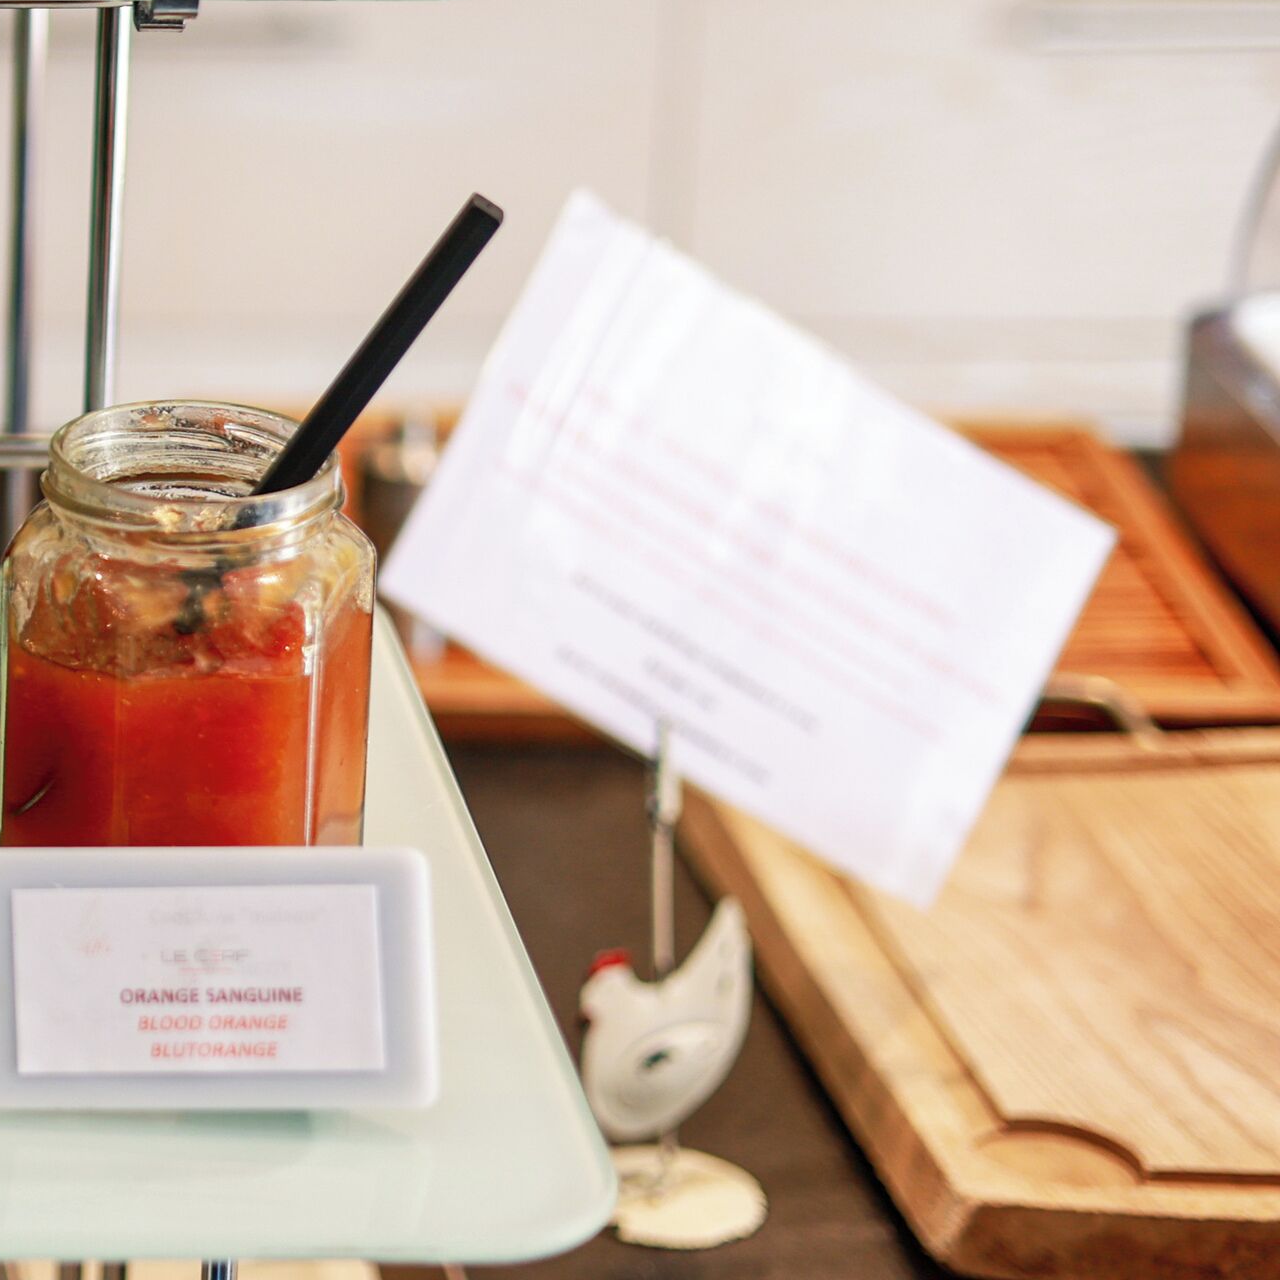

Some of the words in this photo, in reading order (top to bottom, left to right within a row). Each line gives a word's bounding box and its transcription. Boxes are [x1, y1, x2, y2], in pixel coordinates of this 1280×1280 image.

[120, 987, 200, 1005] ORANGE
[205, 986, 303, 1004] SANGUINE
[137, 1015, 202, 1032] BLOOD
[208, 1014, 288, 1032] ORANGE
[150, 1041, 278, 1059] BLUTORANGE
